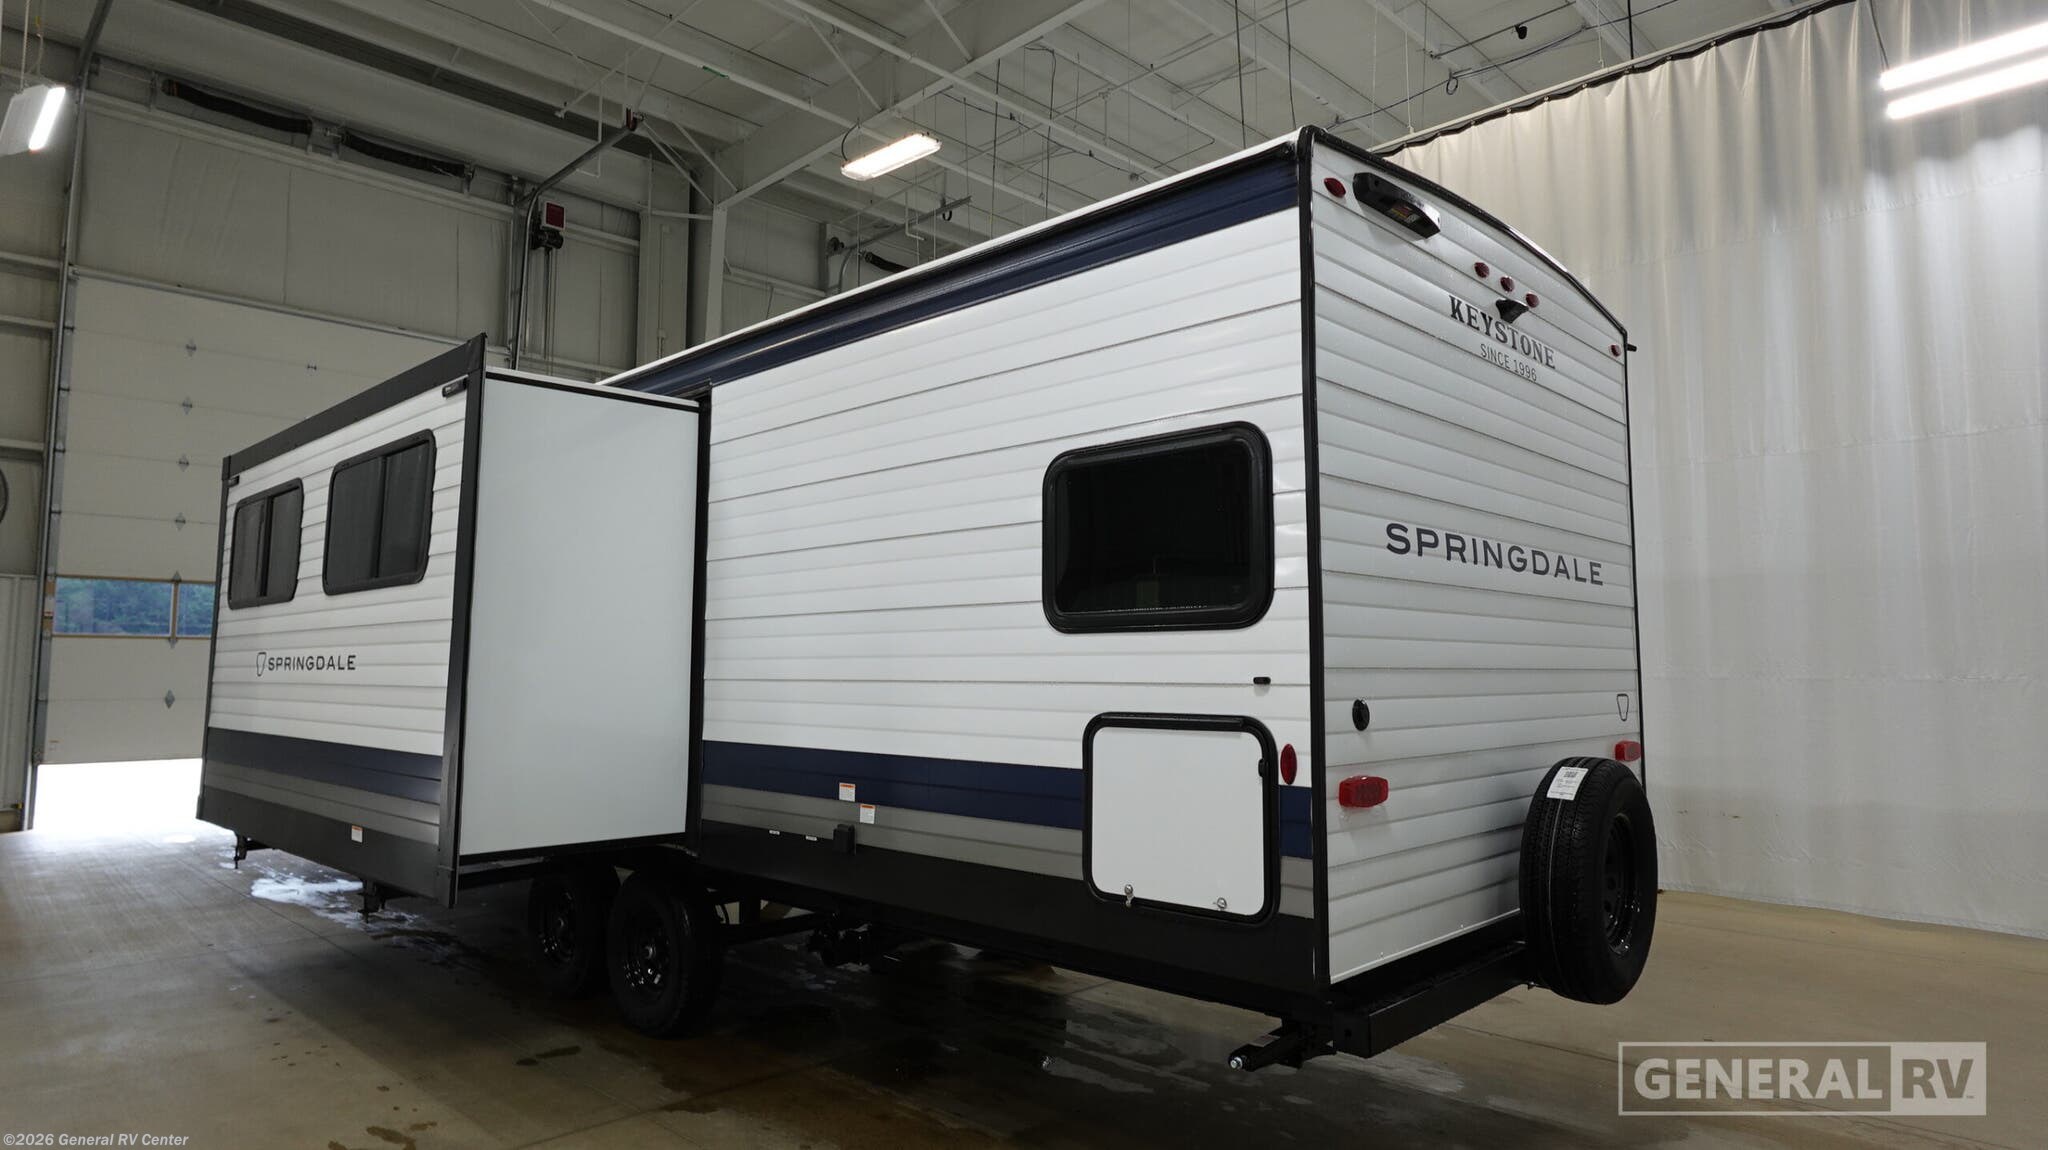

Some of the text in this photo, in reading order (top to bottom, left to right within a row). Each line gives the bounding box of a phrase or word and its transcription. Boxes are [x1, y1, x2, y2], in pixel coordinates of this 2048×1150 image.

[1449, 295, 1556, 370] KEYSTONE
[1480, 343, 1537, 382] SINCE 1996
[1386, 522, 1604, 586] SPRINGDALE
[267, 654, 357, 671] SPRINGDALE
